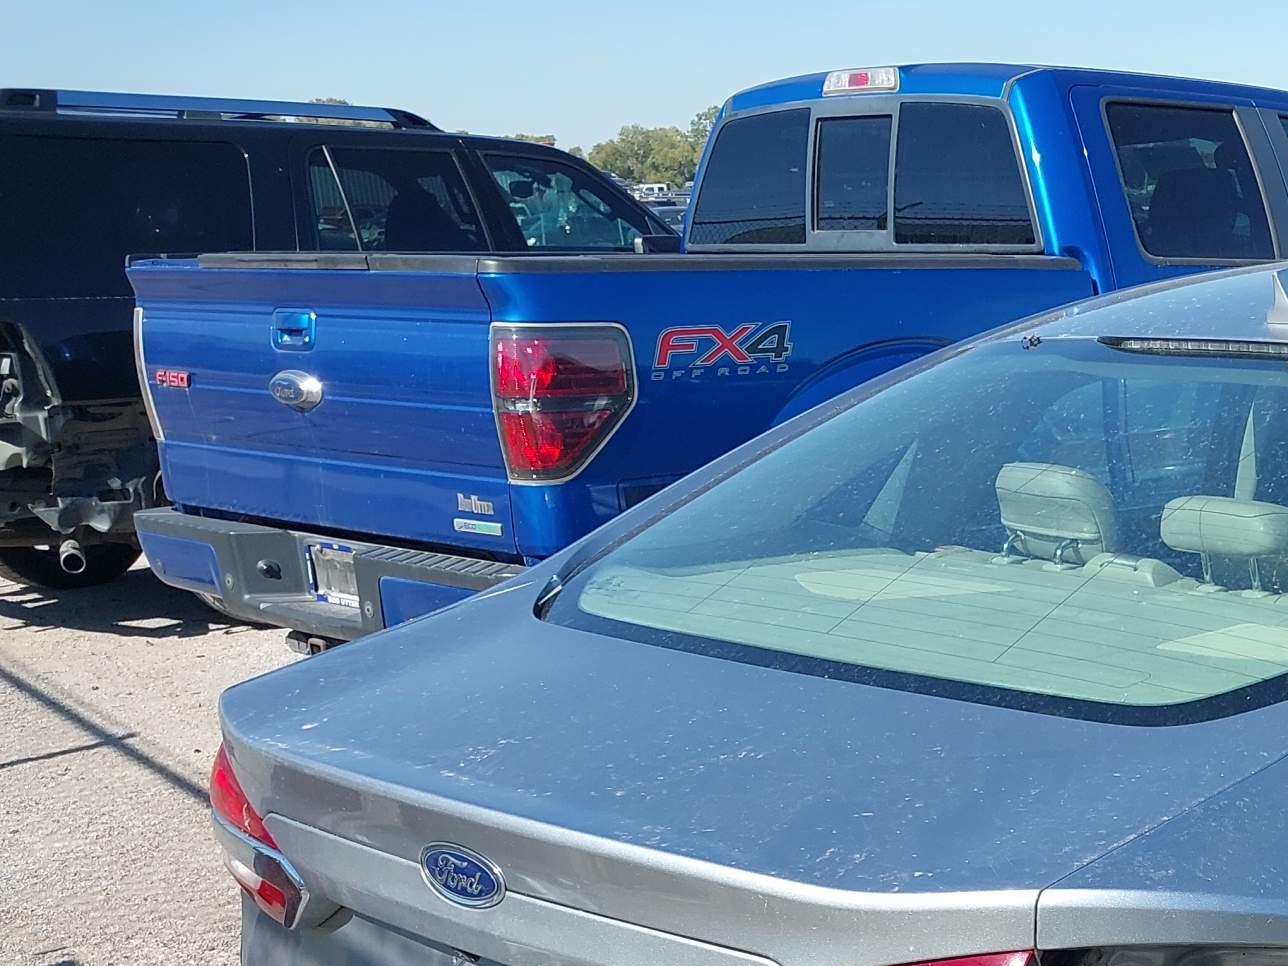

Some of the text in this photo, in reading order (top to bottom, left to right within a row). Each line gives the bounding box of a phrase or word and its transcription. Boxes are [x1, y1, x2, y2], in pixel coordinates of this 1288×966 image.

[651, 320, 793, 369] FX4
[650, 364, 790, 381] OFF ROAD
[431, 853, 488, 896] Ford
